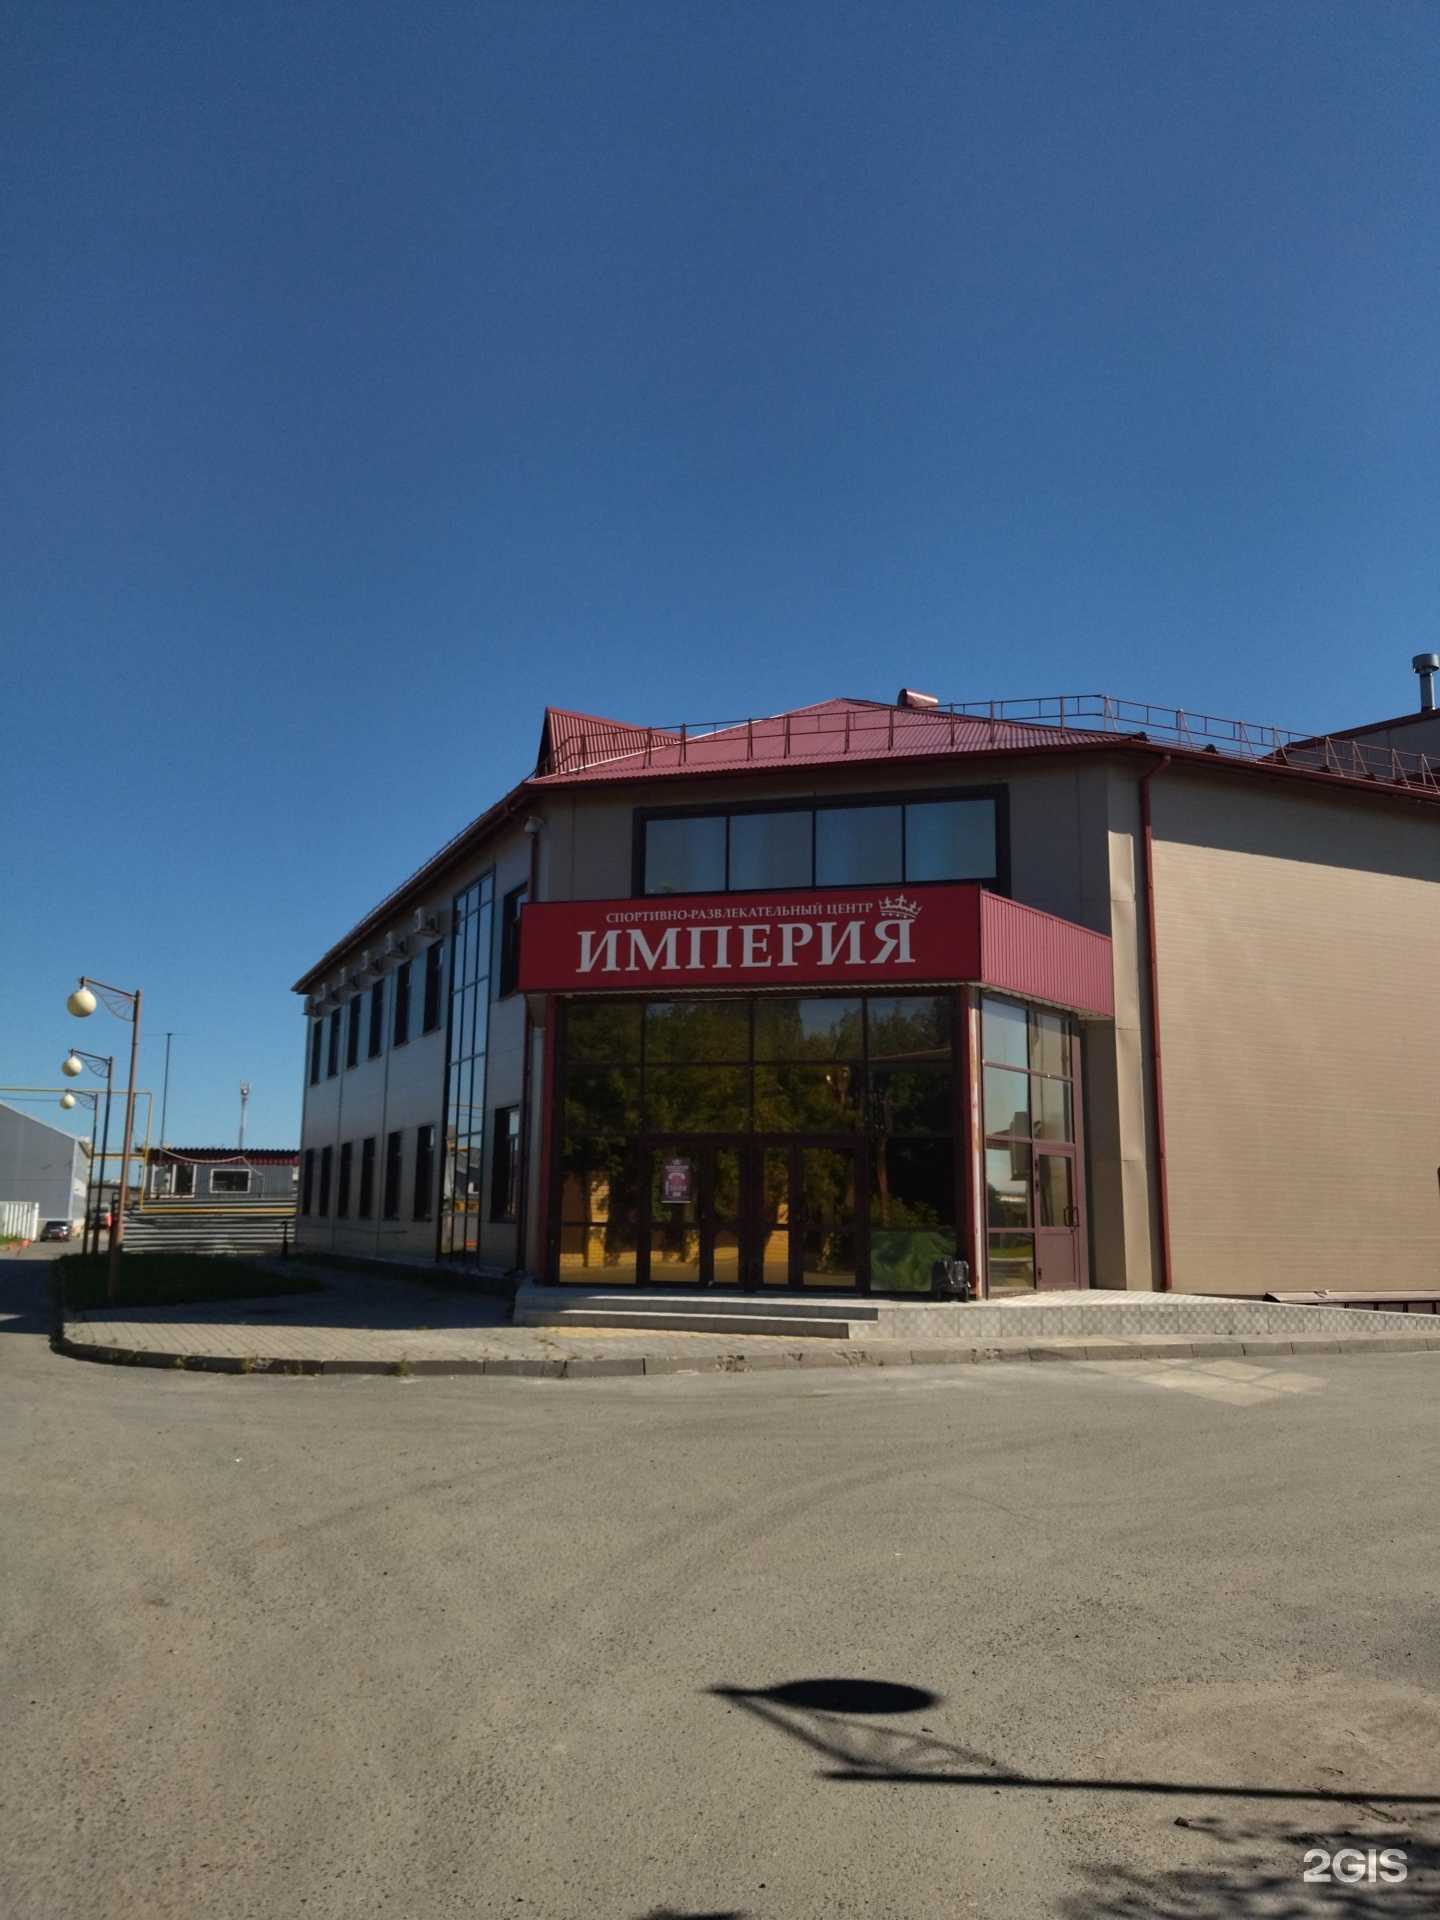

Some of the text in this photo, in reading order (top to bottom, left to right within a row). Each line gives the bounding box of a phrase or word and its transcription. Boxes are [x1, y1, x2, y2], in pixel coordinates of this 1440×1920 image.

[606, 902, 873, 923] СПОРТИВНО-РАЗВЛЕКАТЕЛЬНЫЙ ЦЕНТР
[575, 918, 916, 973] ИМПЕРИЯ
